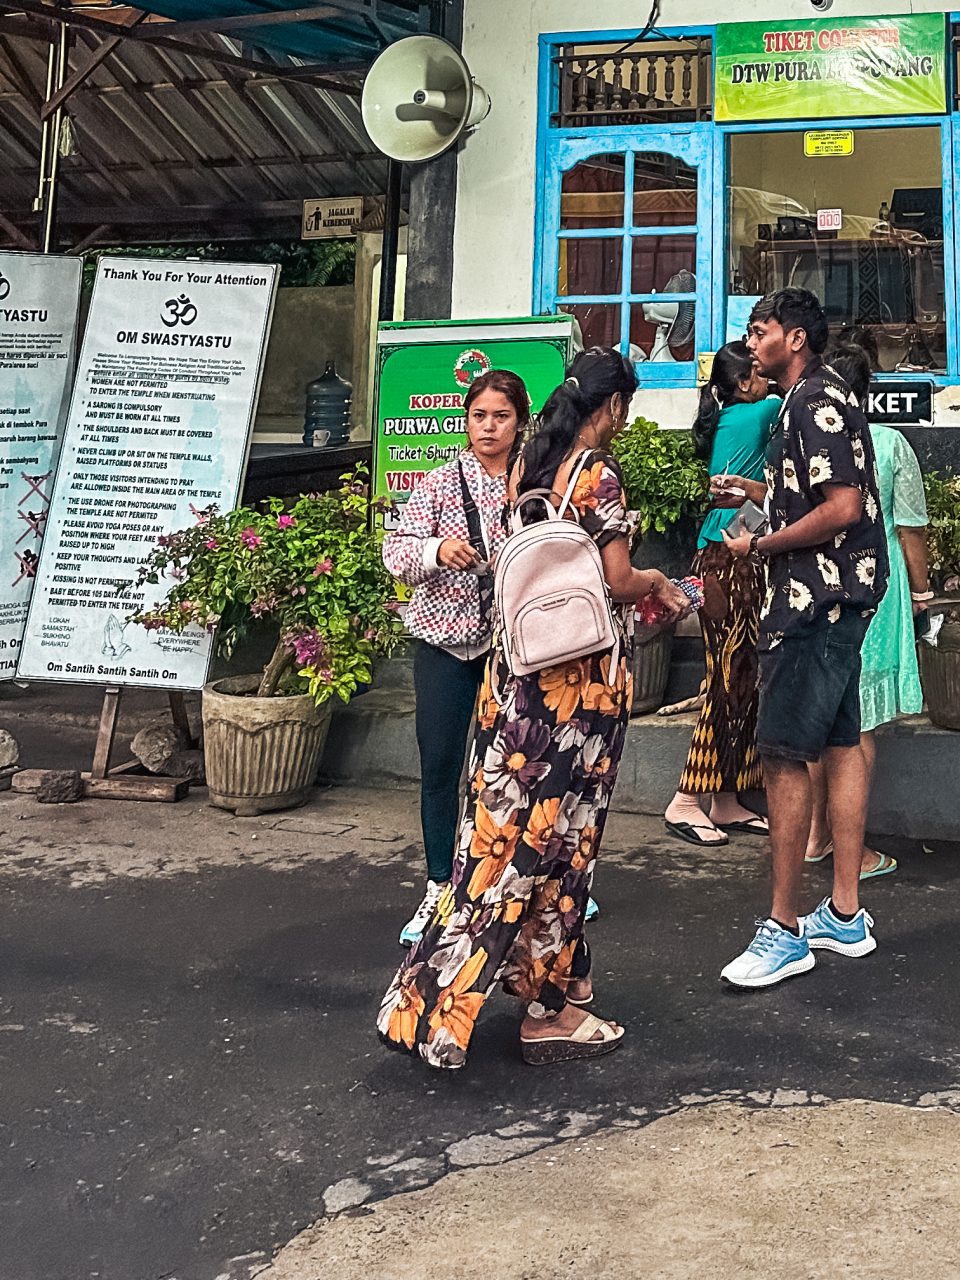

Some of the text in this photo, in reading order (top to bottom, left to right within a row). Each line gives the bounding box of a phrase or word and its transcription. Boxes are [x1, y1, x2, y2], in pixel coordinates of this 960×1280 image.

[763, 31, 815, 53] TIKET
[732, 63, 771, 84] DTW
[774, 60, 822, 82] PURA
[102, 268, 267, 286] Thank You For Your Attention
[0, 309, 48, 322] YASTU
[116, 331, 231, 348] OM SWASTYASTU
[171, 392, 215, 400] MENSTRUATING
[409, 394, 462, 410] KOPER
[867, 392, 919, 414] KET
[95, 425, 129, 433] SHOULDERS
[384, 417, 440, 436] PURWA
[169, 452, 191, 460] TEMPLE
[388, 445, 422, 461] Ticket
[75, 457, 97, 465] RAISED
[97, 458, 132, 467] PLATFORMS
[142, 461, 168, 469] STATUES
[109, 475, 136, 483] VISITORS
[137, 476, 169, 484] INTENDING
[83, 484, 110, 492] ALLOWED
[111, 485, 131, 493] INSIDE
[199, 490, 221, 498] TEMPLE
[67, 497, 80, 505] THE
[127, 501, 176, 510] PHOTOGRAPHING
[78, 508, 101, 516] TEMPLE
[128, 511, 157, 519] PERMITED
[60, 530, 88, 538] POSITION
[59, 540, 80, 548] RAISED
[56, 552, 71, 560] KEEP
[73, 553, 89, 561] YOUR
[90, 554, 122, 562] THOUGHTS
[54, 563, 81, 571] POSITIVE
[46, 662, 178, 679] Om Santih Santih Santih Om
